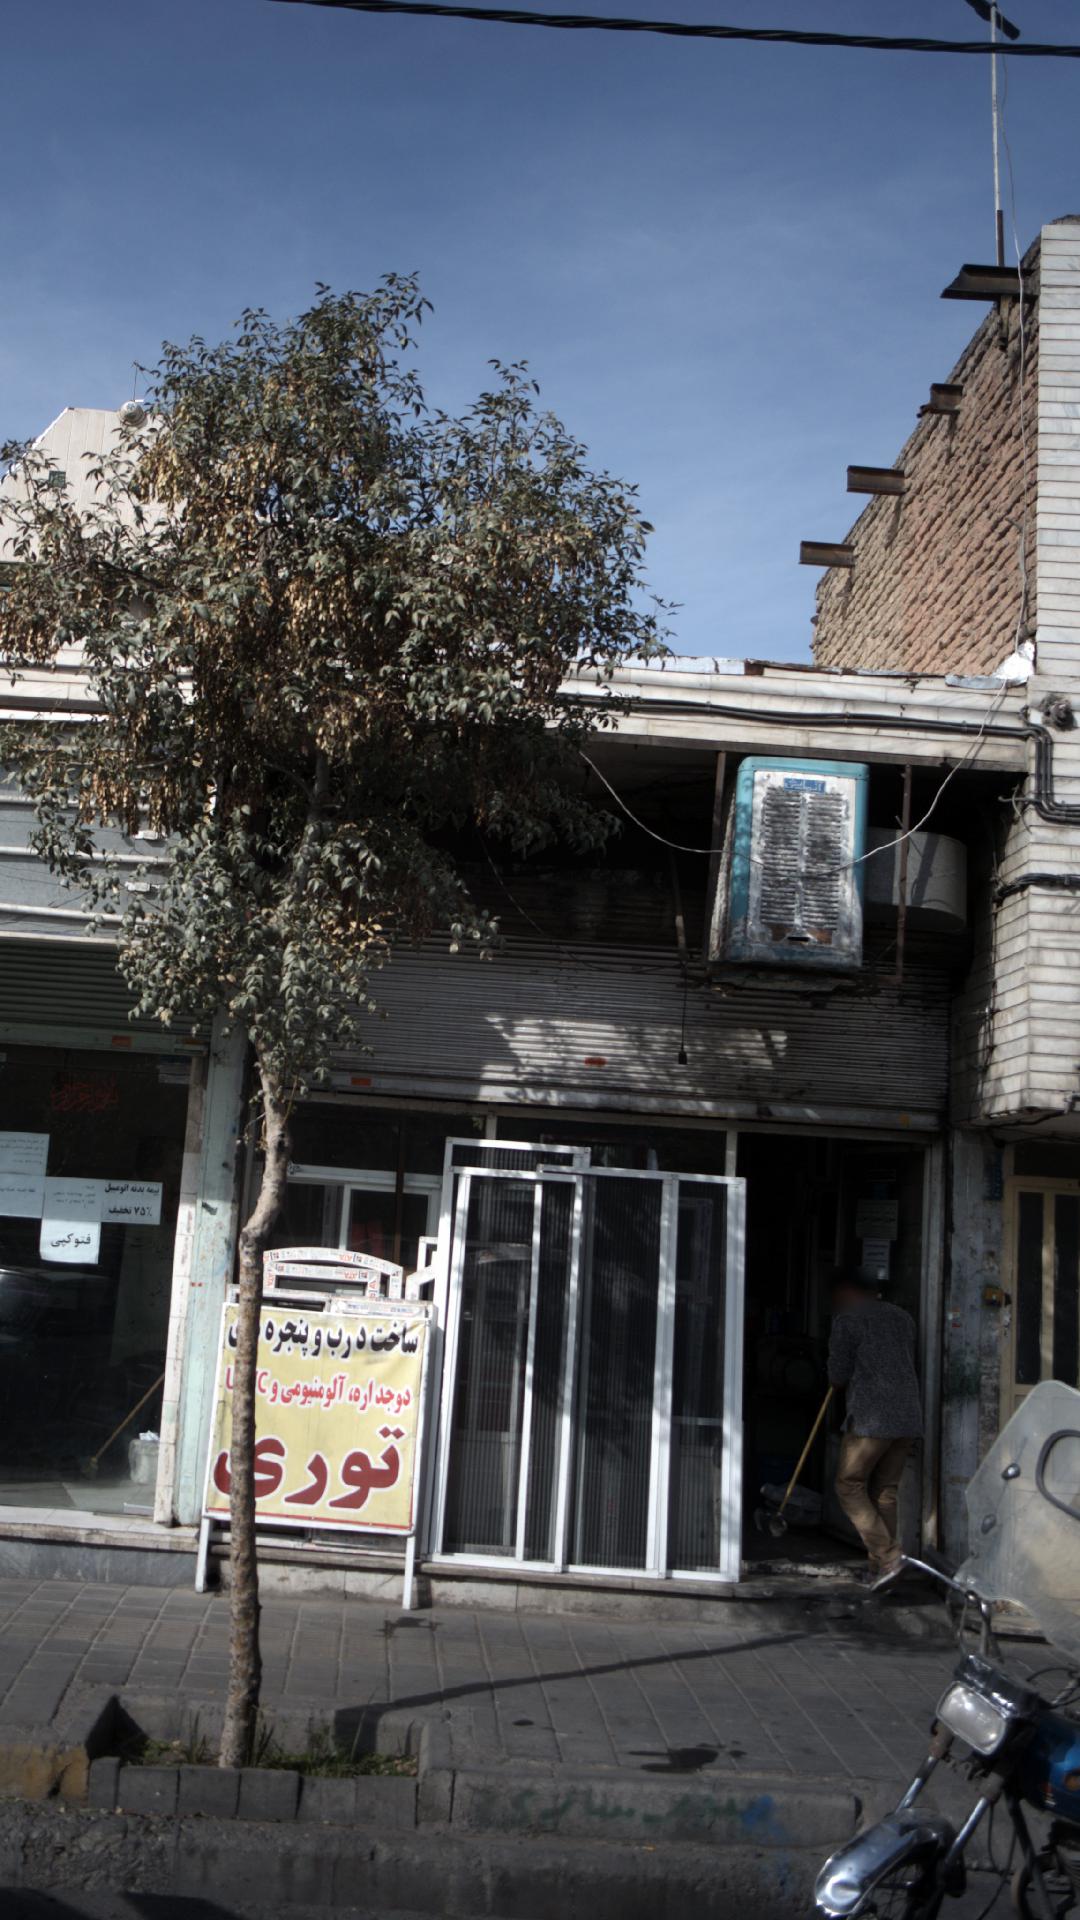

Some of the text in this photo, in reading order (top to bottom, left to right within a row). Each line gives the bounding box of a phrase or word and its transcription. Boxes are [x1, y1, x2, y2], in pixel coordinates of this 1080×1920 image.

[131, 1185, 145, 1193] بدنه
[146, 1186, 160, 1196] بیمه
[108, 1205, 131, 1215] تخفیف
[50, 1233, 91, 1248] فتوکپی
[265, 1319, 309, 1357] پنجره
[311, 1329, 322, 1356] و
[327, 1327, 367, 1359] درب
[371, 1322, 418, 1353] ساخت
[226, 1367, 268, 1394] UC
[270, 1381, 278, 1402] و
[214, 1426, 405, 1510] توری
